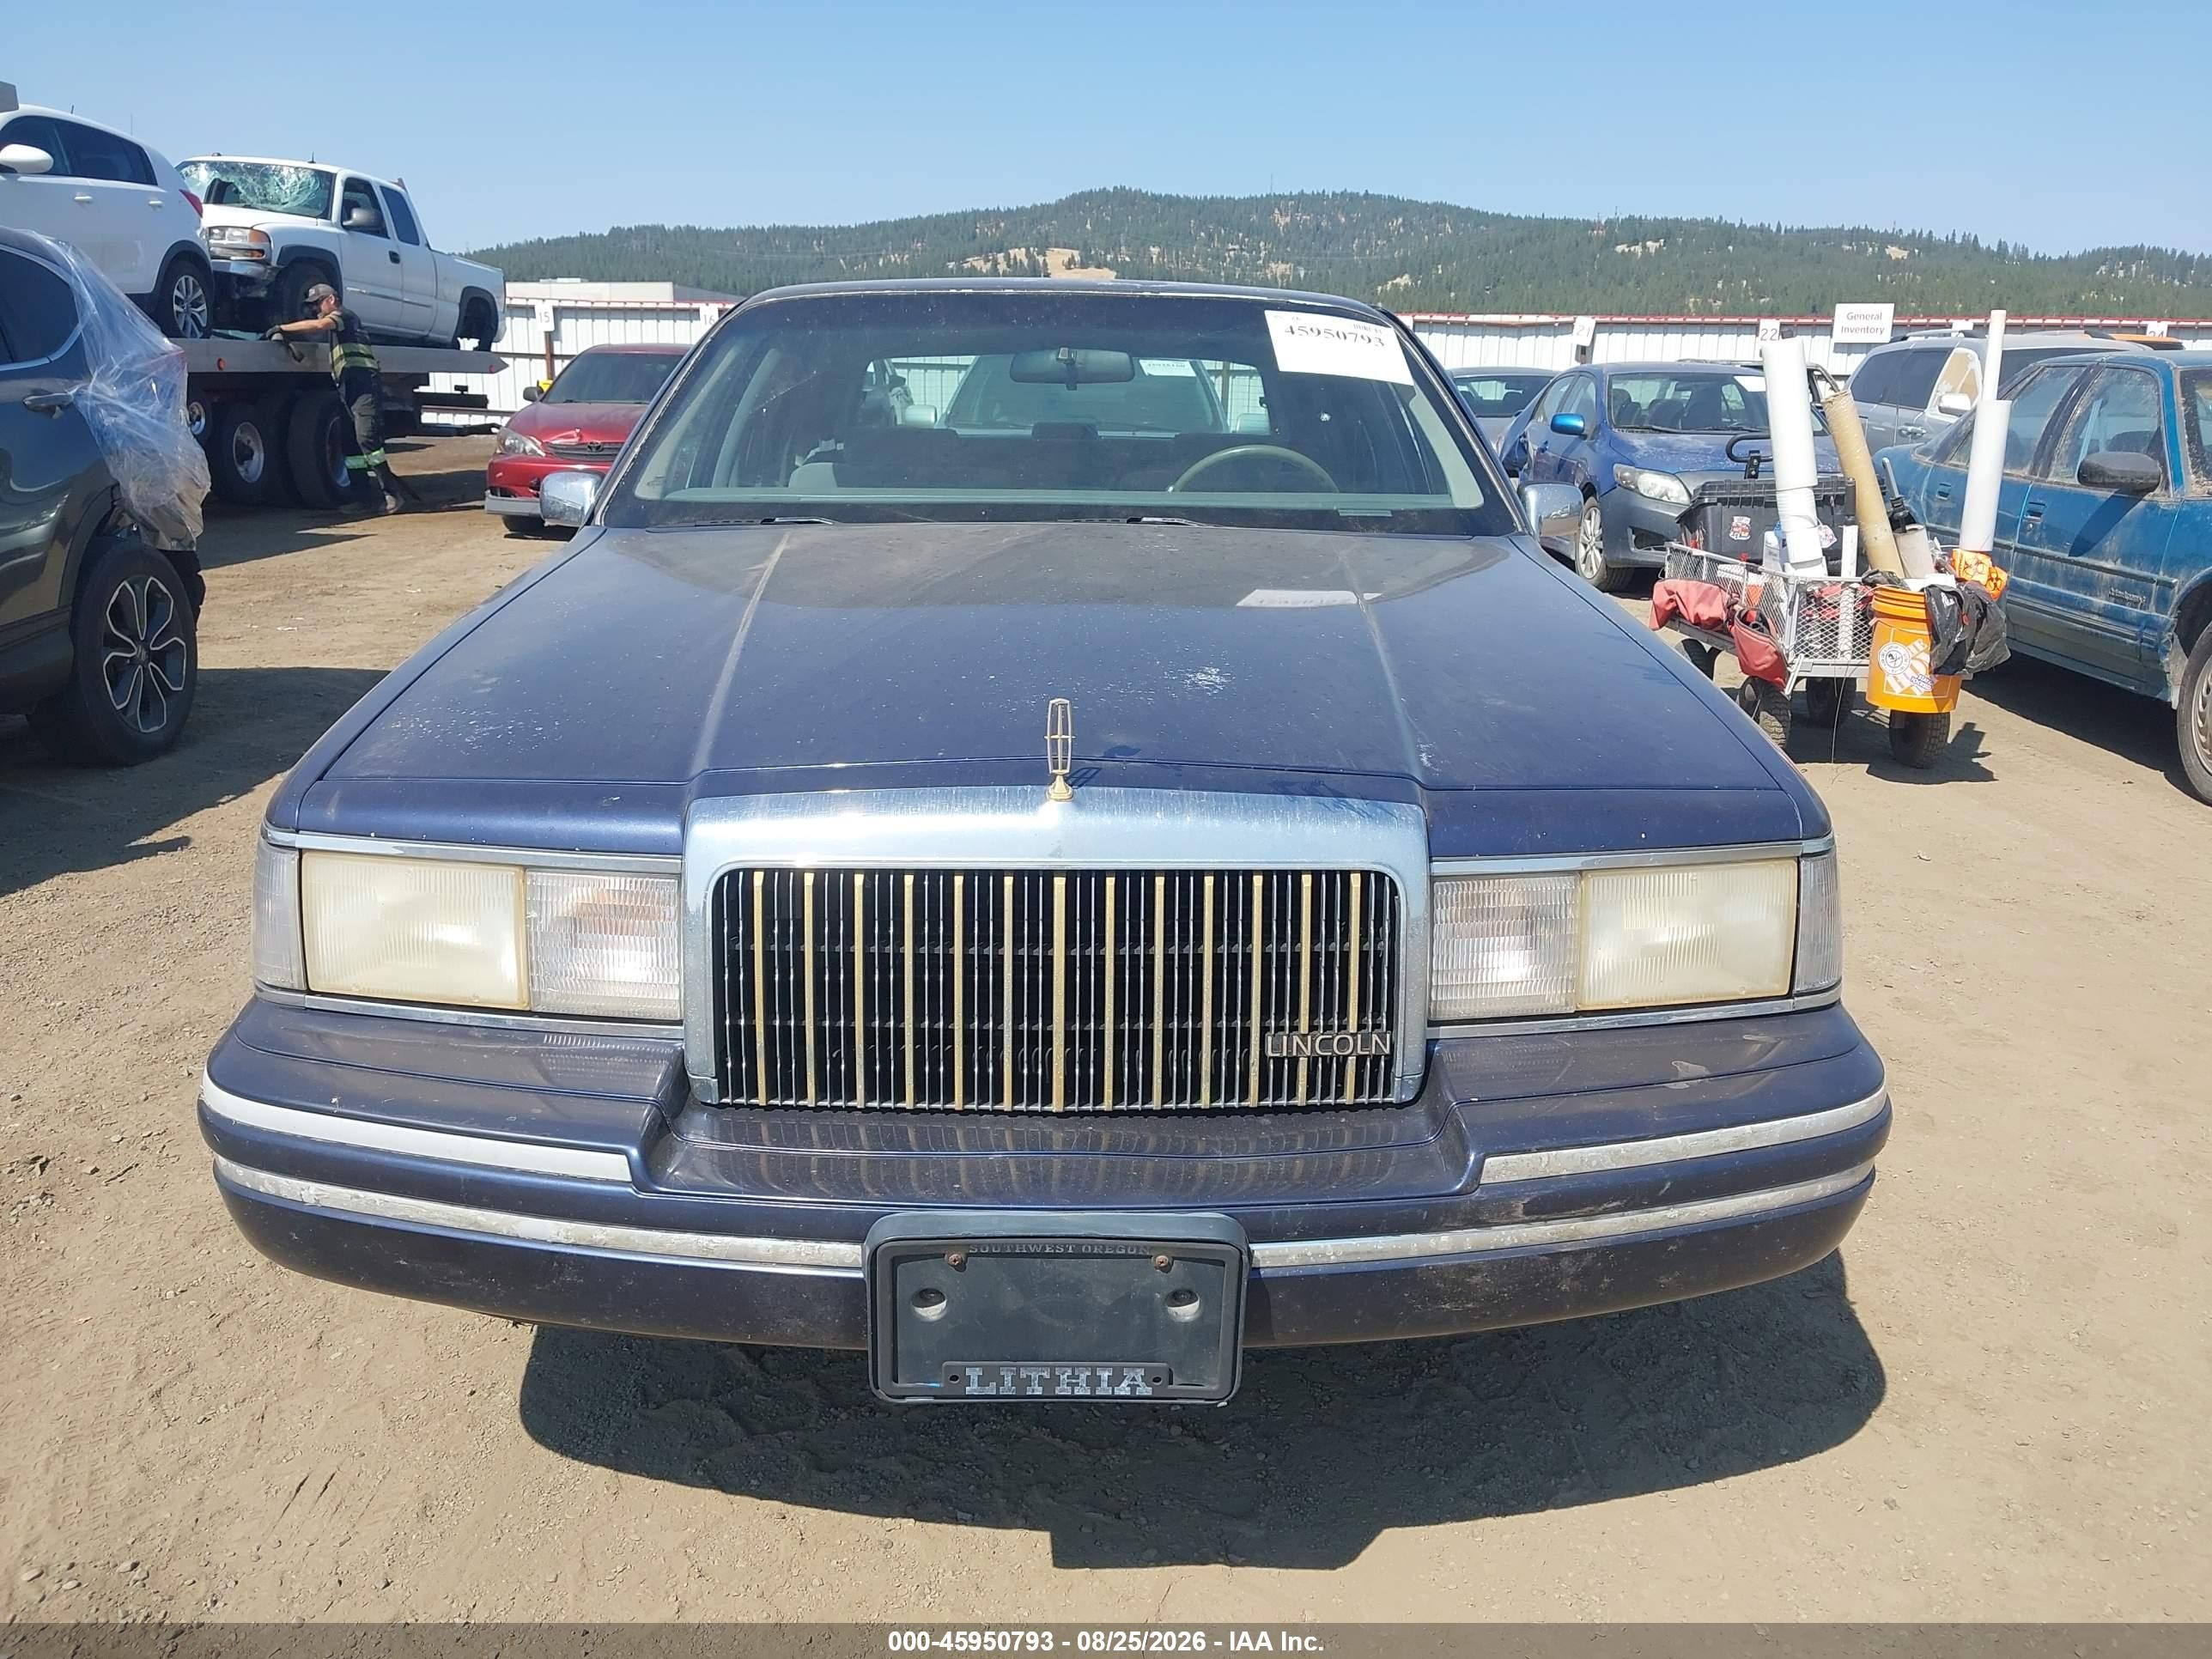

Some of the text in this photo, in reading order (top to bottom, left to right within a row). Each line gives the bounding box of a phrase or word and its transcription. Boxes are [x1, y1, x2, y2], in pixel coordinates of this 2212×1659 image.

[539, 311, 550, 323] 15
[703, 313, 715, 325] 16
[1846, 312, 1882, 320] General
[1284, 325, 1385, 347] 45950793
[1760, 328, 1778, 341] 22
[1841, 325, 1885, 336] Inventory
[1267, 1033, 1391, 1057] LINCOLN
[969, 1243, 1152, 1255] SOUTHWEST OREGON
[965, 1367, 1152, 1395] LITHIA
